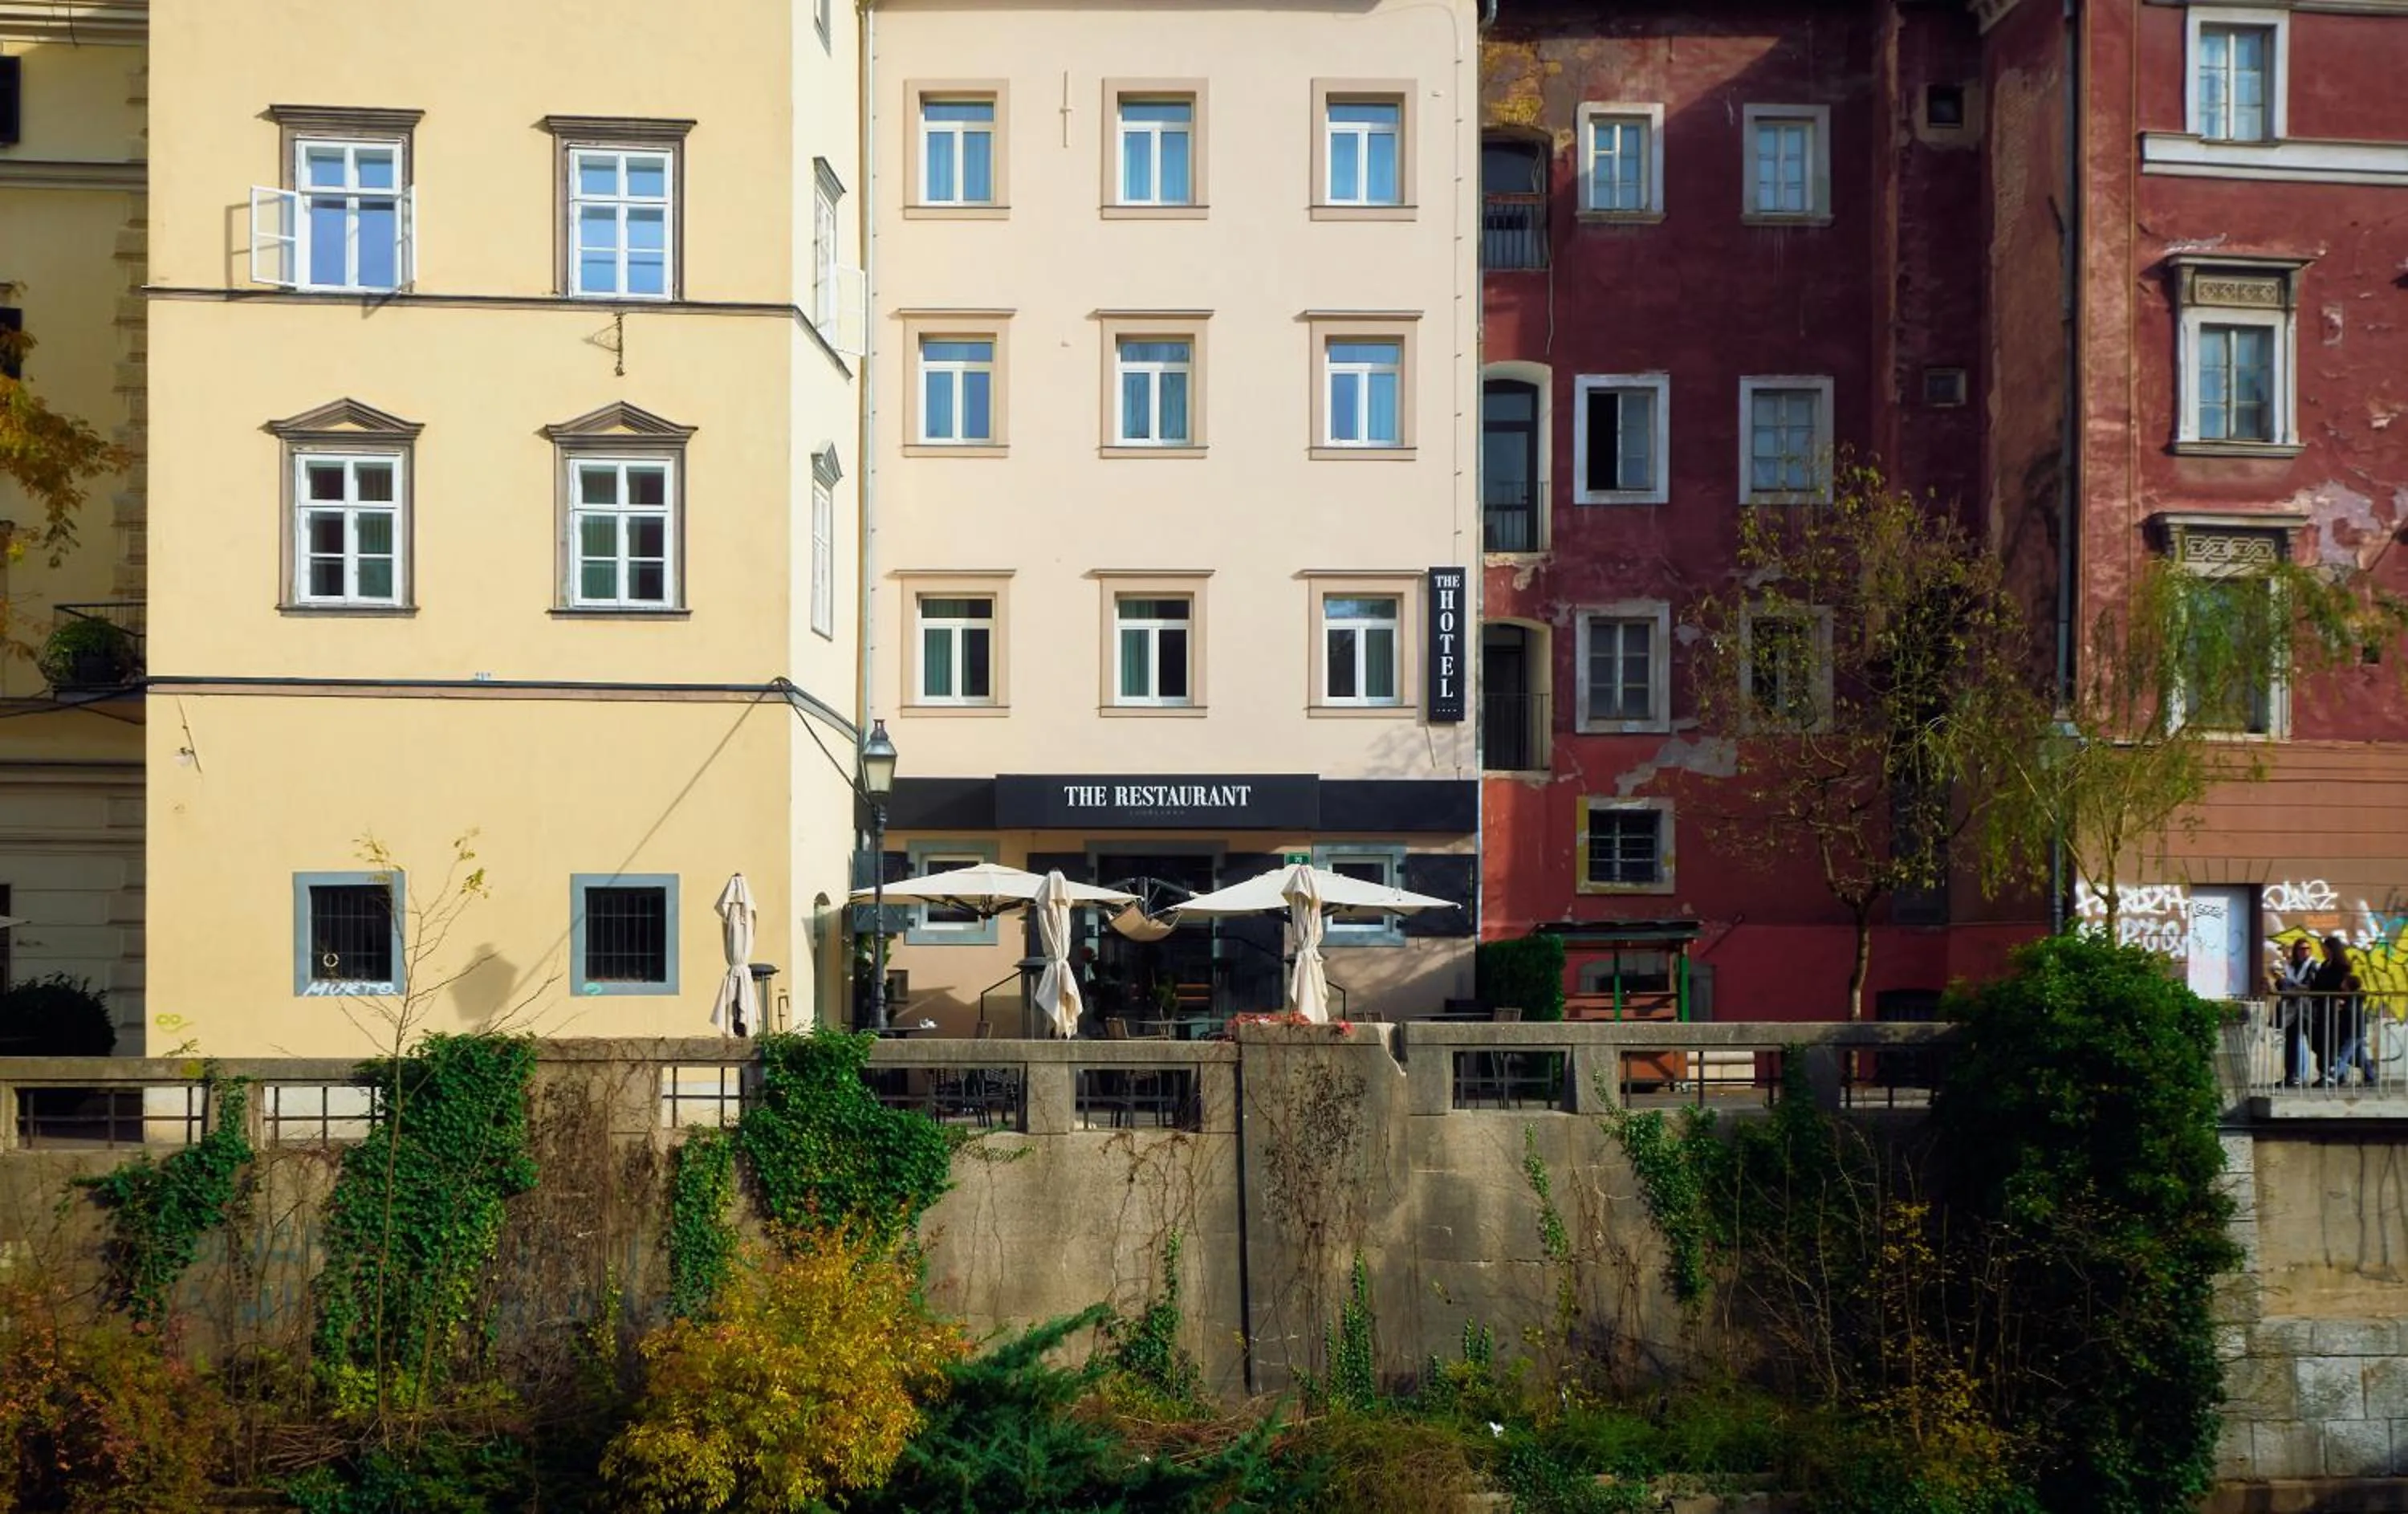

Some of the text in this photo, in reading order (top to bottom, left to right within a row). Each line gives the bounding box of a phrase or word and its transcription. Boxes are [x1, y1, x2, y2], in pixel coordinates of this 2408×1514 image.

[1435, 575, 1460, 588] THE
[1439, 590, 1454, 698] HOTEL
[1064, 786, 1251, 807] THE RESTAURANT
